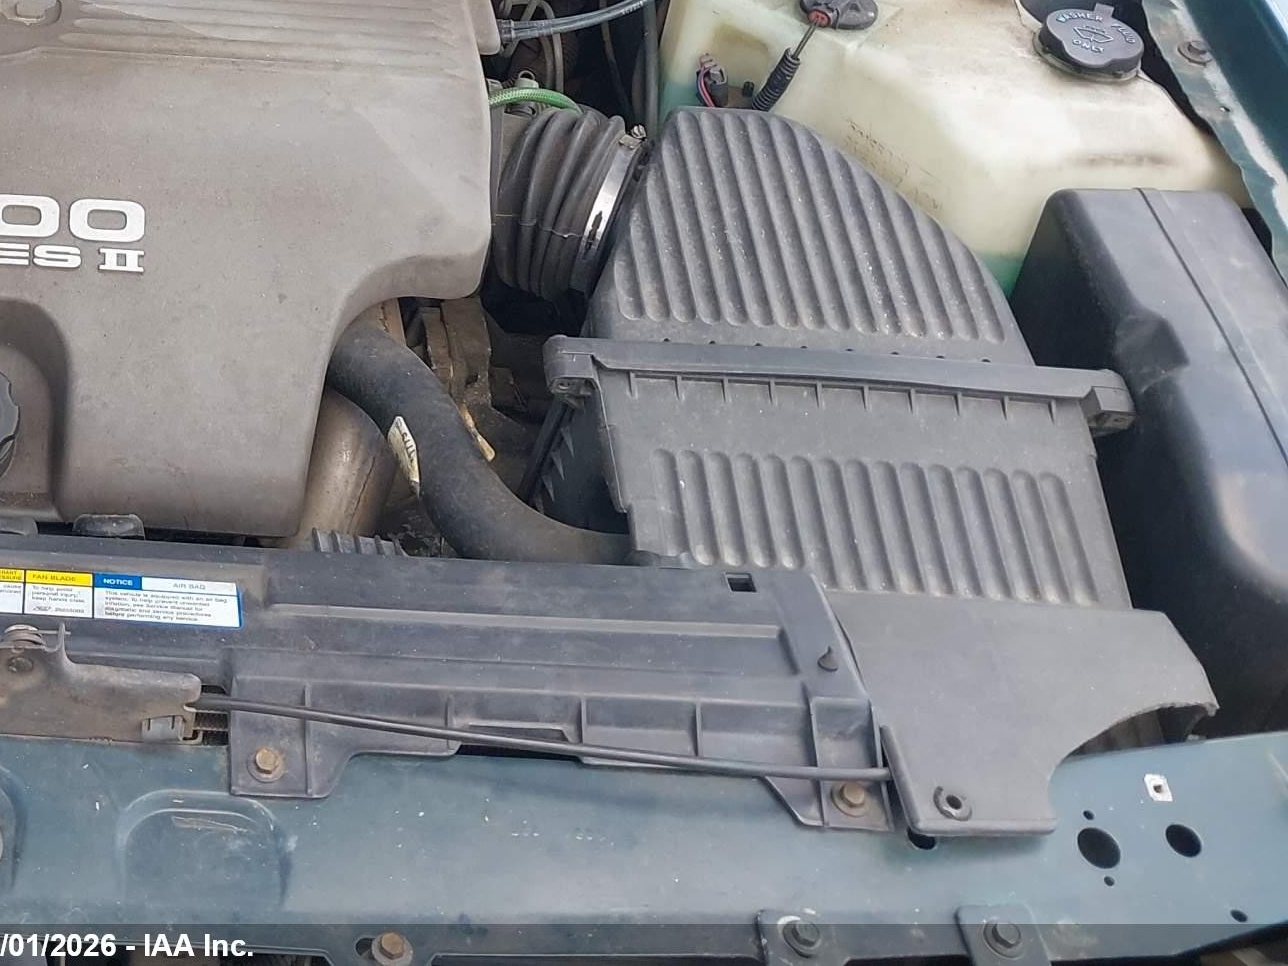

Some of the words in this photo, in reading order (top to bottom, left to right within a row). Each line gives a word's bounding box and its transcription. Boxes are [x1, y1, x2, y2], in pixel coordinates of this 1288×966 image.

[1056, 11, 1103, 23] WASHER
[1072, 38, 1105, 53] ONLY
[98, 247, 146, 274] II
[103, 577, 133, 586] NOTICE
